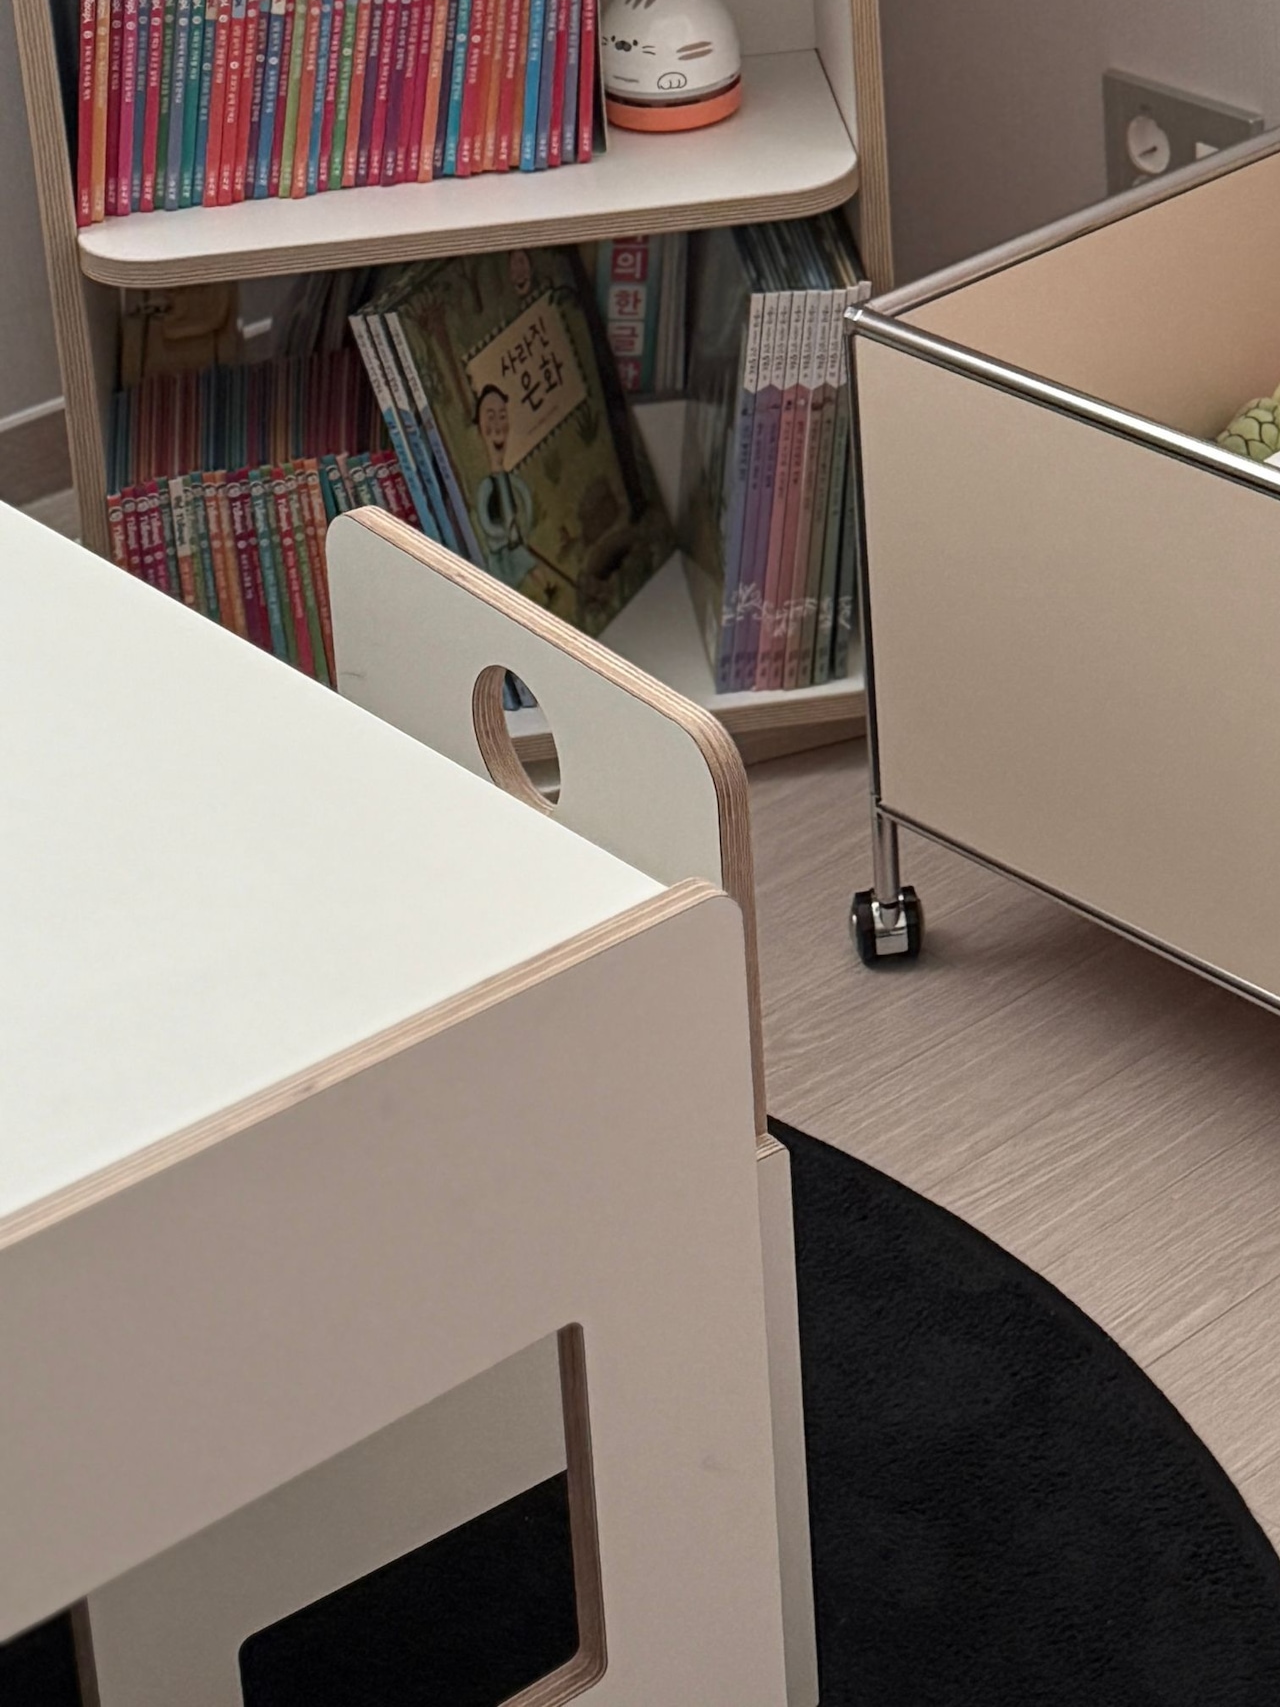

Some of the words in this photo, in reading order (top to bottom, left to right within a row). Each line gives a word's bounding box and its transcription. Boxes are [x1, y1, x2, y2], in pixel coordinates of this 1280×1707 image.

[500, 316, 550, 378] 사라진
[610, 289, 643, 352] 한글
[520, 351, 565, 413] 은화
